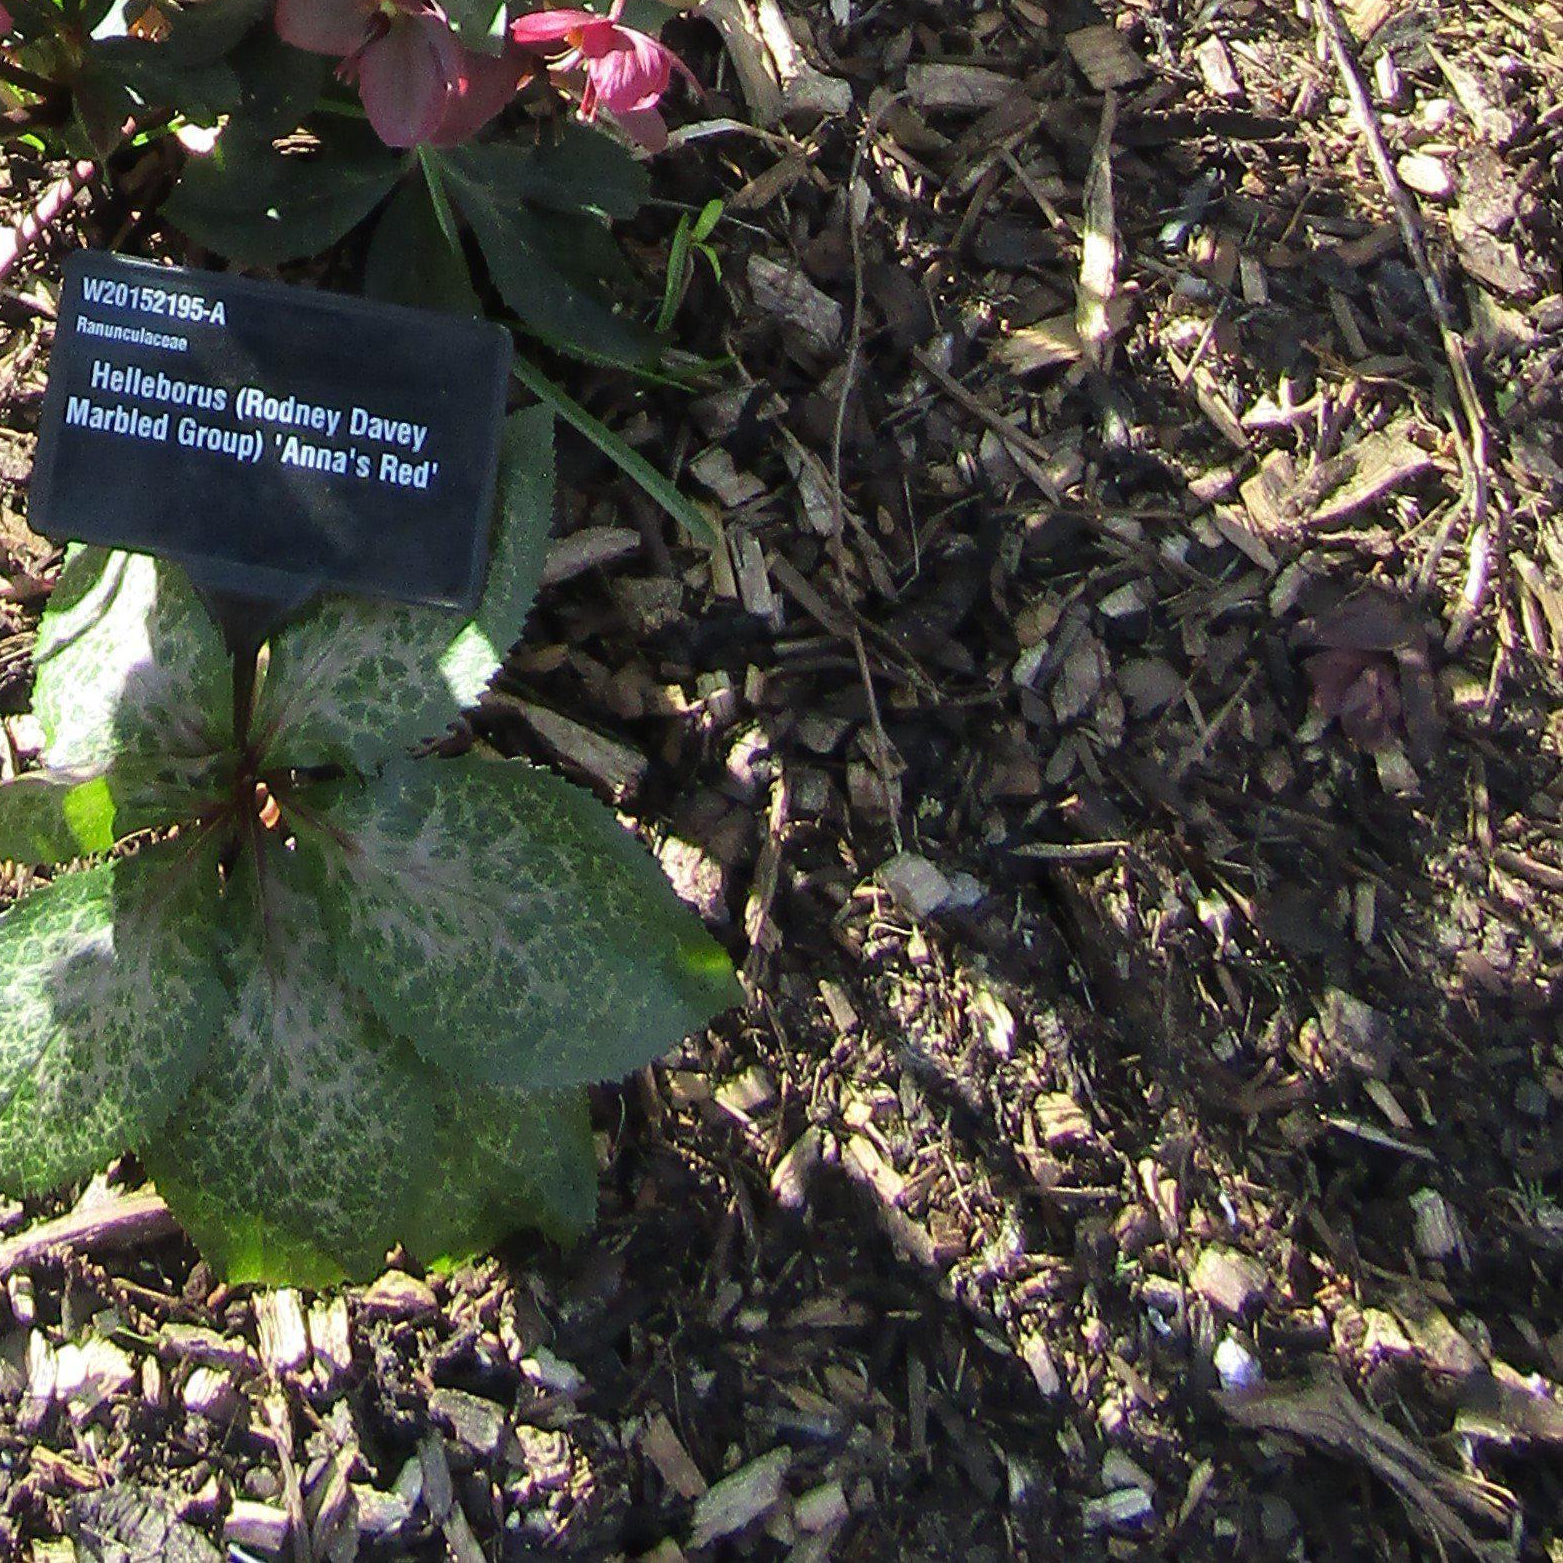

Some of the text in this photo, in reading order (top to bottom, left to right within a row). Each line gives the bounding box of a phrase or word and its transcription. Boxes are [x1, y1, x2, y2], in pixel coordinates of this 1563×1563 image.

[76, 315, 189, 352] Ranunculaceae
[81, 277, 226, 326] W20152195-A
[90, 360, 428, 453] Helleborus (Rodney Davey
[65, 396, 439, 489] Marbled Group) 'Anna's Red'
